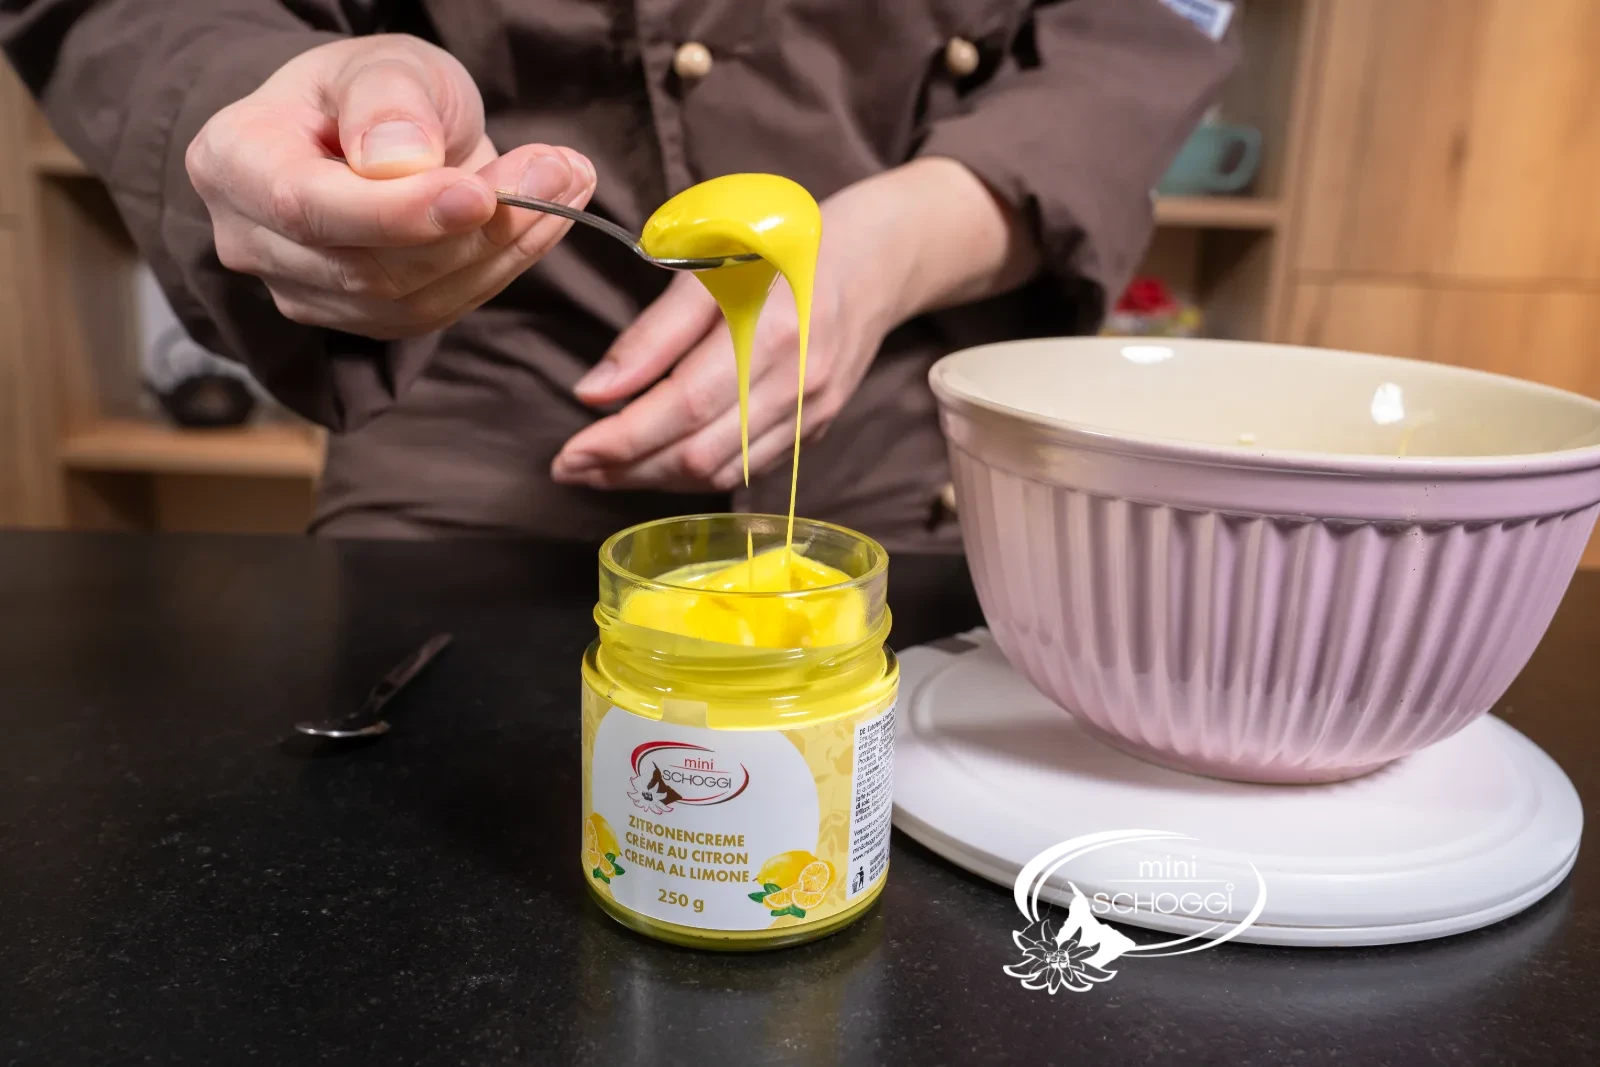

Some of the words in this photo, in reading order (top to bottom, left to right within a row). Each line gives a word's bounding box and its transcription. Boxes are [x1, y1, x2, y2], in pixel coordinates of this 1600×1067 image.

[684, 757, 714, 770] mini
[662, 769, 732, 789] SCHOGGI
[628, 815, 745, 847] ZITRONENCREME
[625, 831, 664, 855] CRÈME
[667, 848, 688, 860] AU
[691, 852, 748, 865] CITRON
[624, 848, 666, 874] CREMA
[669, 864, 686, 877] AL
[689, 867, 750, 883] LIMONE
[657, 888, 689, 907] 250
[692, 897, 705, 913] g
